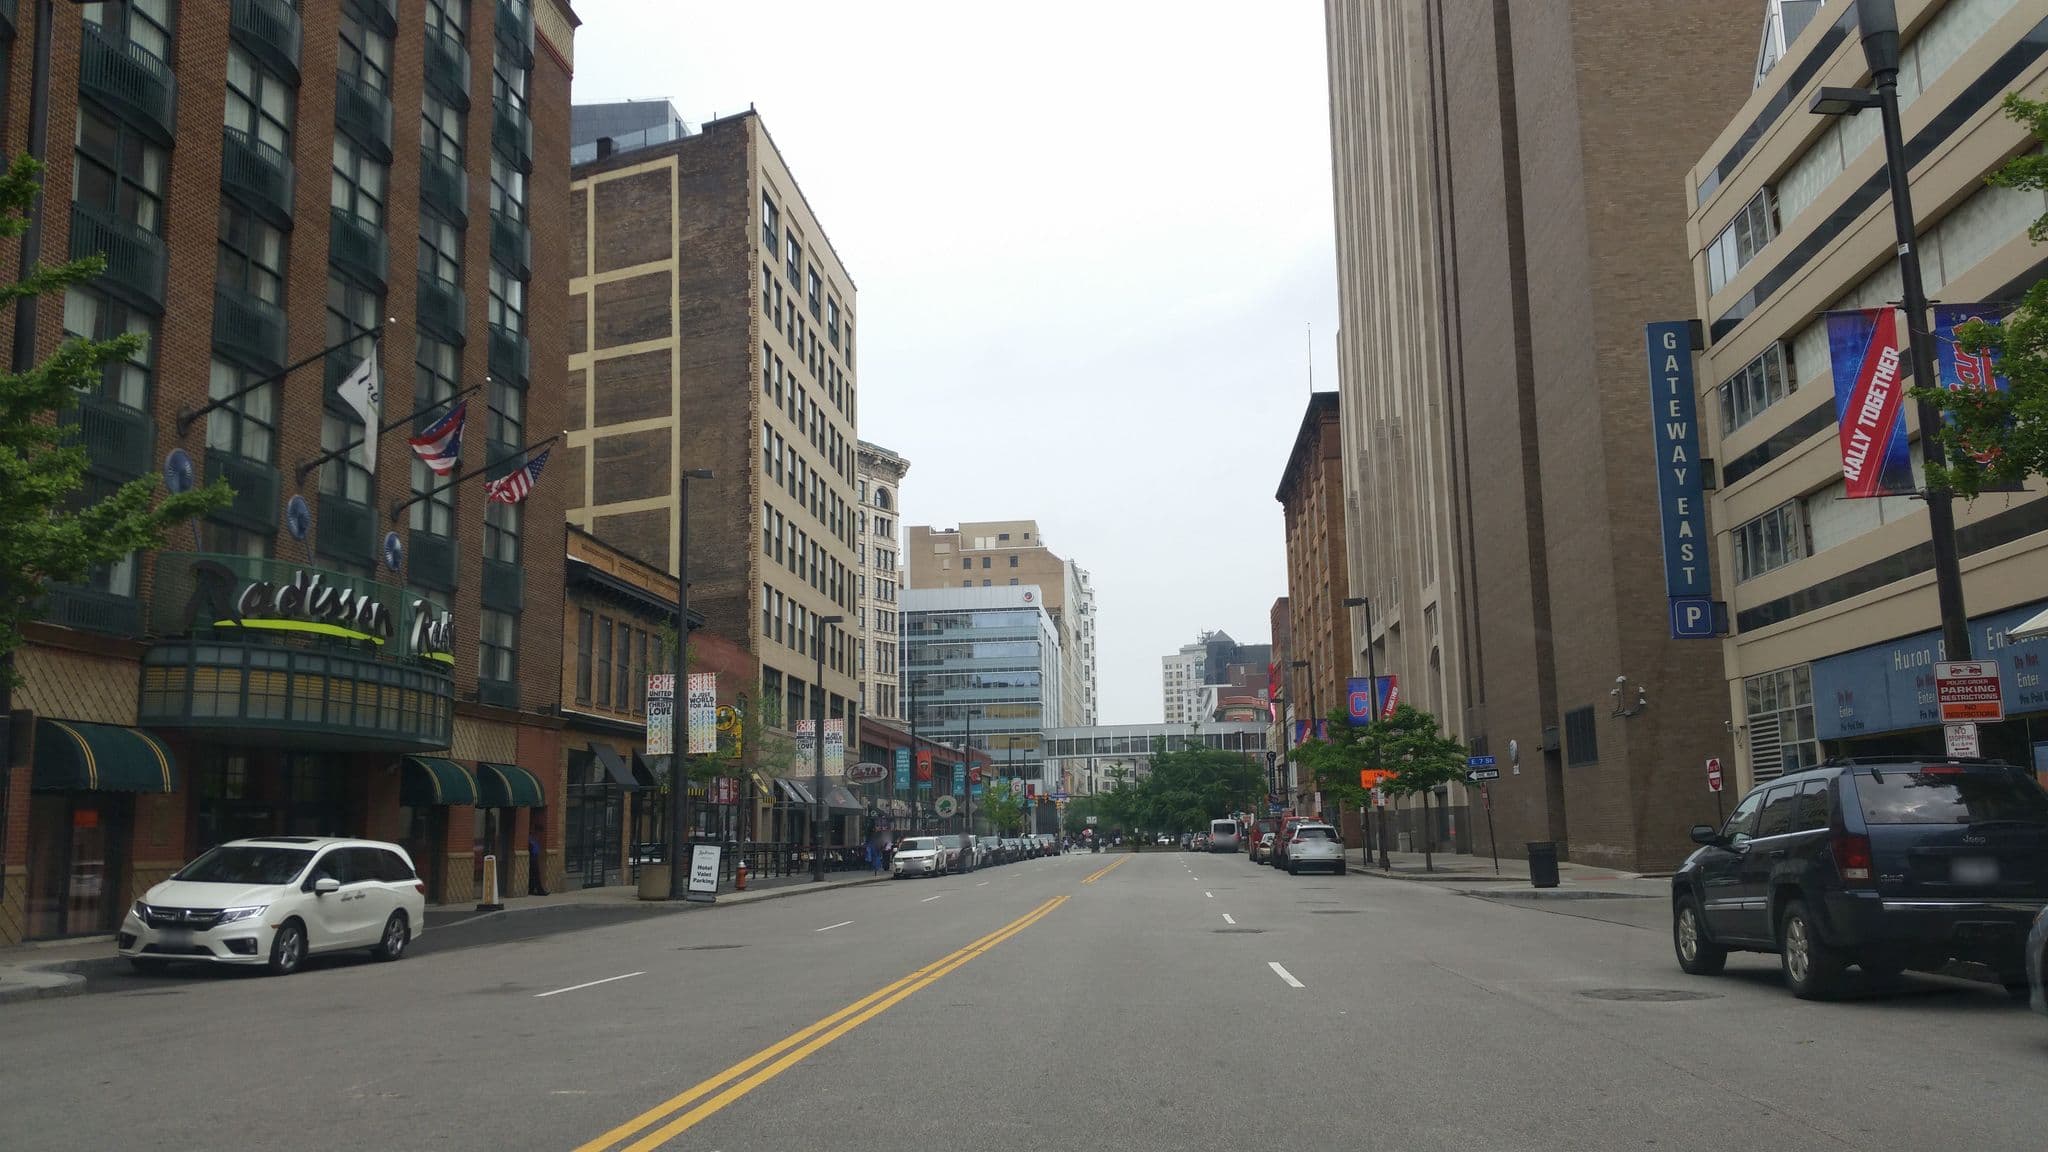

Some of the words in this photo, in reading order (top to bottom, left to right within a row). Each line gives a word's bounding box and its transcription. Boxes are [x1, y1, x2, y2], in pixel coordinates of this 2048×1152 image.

[1843, 428, 1872, 482] RALLY
[1858, 345, 1900, 429] TOGETHER
[1662, 332, 1687, 486] GATEWAY
[1677, 498, 1696, 585] EAST
[183, 559, 394, 636] Radisson
[1686, 606, 1702, 628] P
[1894, 648, 1931, 671] Huron
[1940, 685, 1997, 695] PARKING
[2017, 672, 2040, 688] Enter
[690, 697, 715, 705] WORLD
[1349, 691, 1368, 717] C
[1941, 692, 1999, 701] RESTRICTIONS
[649, 707, 671, 716] LOVE
